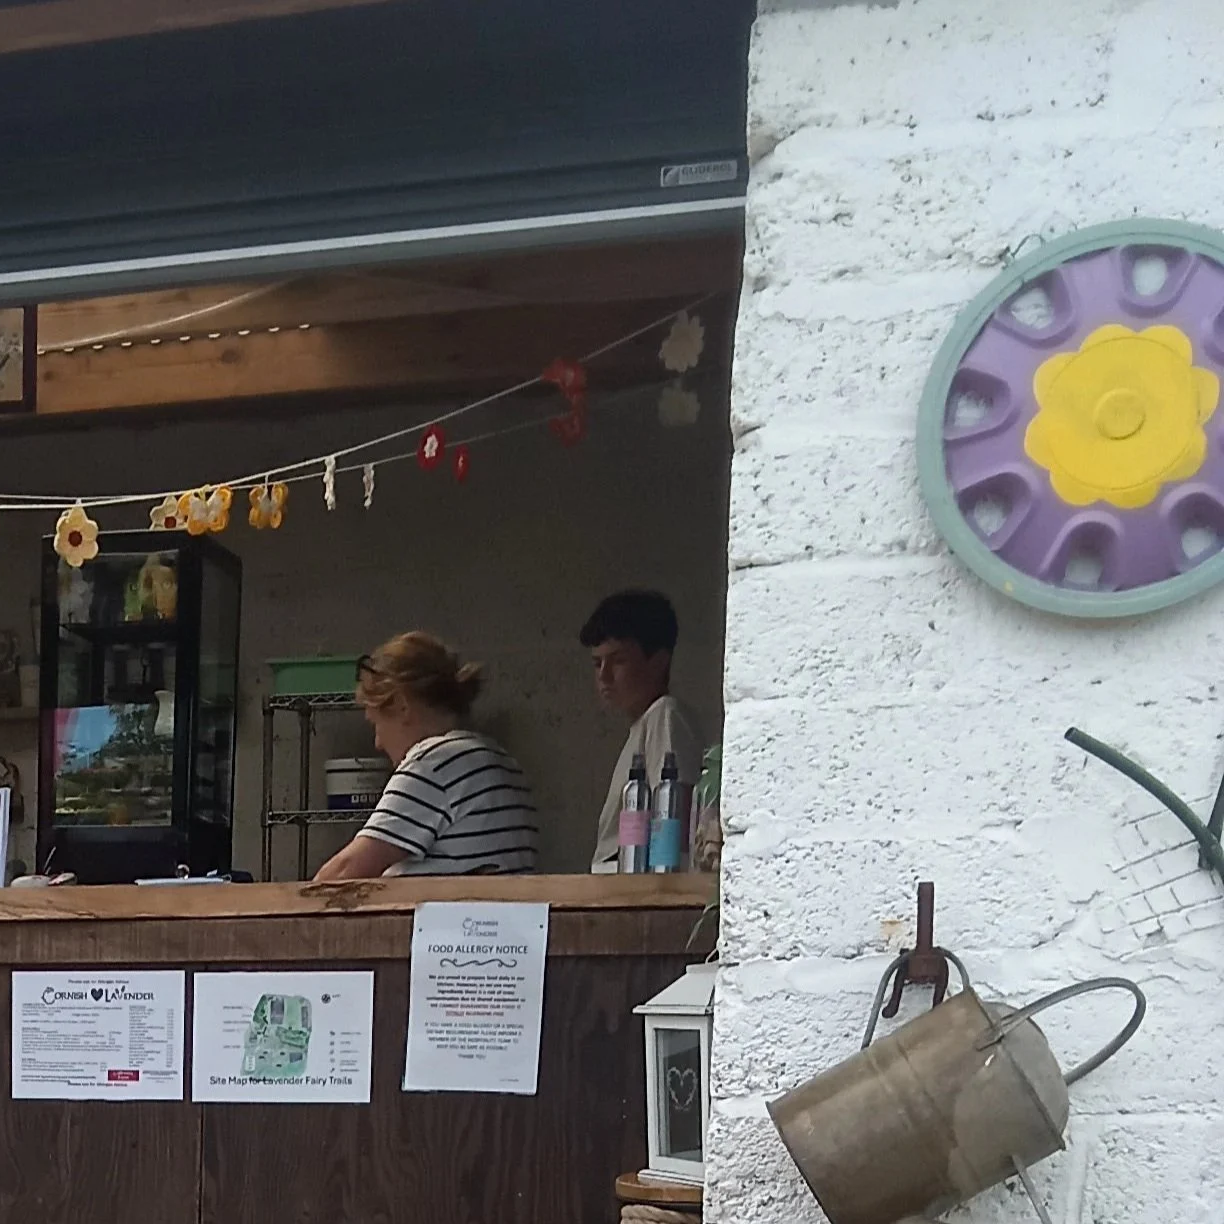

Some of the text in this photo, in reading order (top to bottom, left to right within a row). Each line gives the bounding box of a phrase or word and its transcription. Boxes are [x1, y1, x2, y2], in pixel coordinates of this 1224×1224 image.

[428, 944, 528, 954] FOOD ALLERGY NOTICE
[41, 985, 154, 1005] CORNISH LAVENDER
[210, 1076, 352, 1087] Site Map for Lavender Fairy Trails
